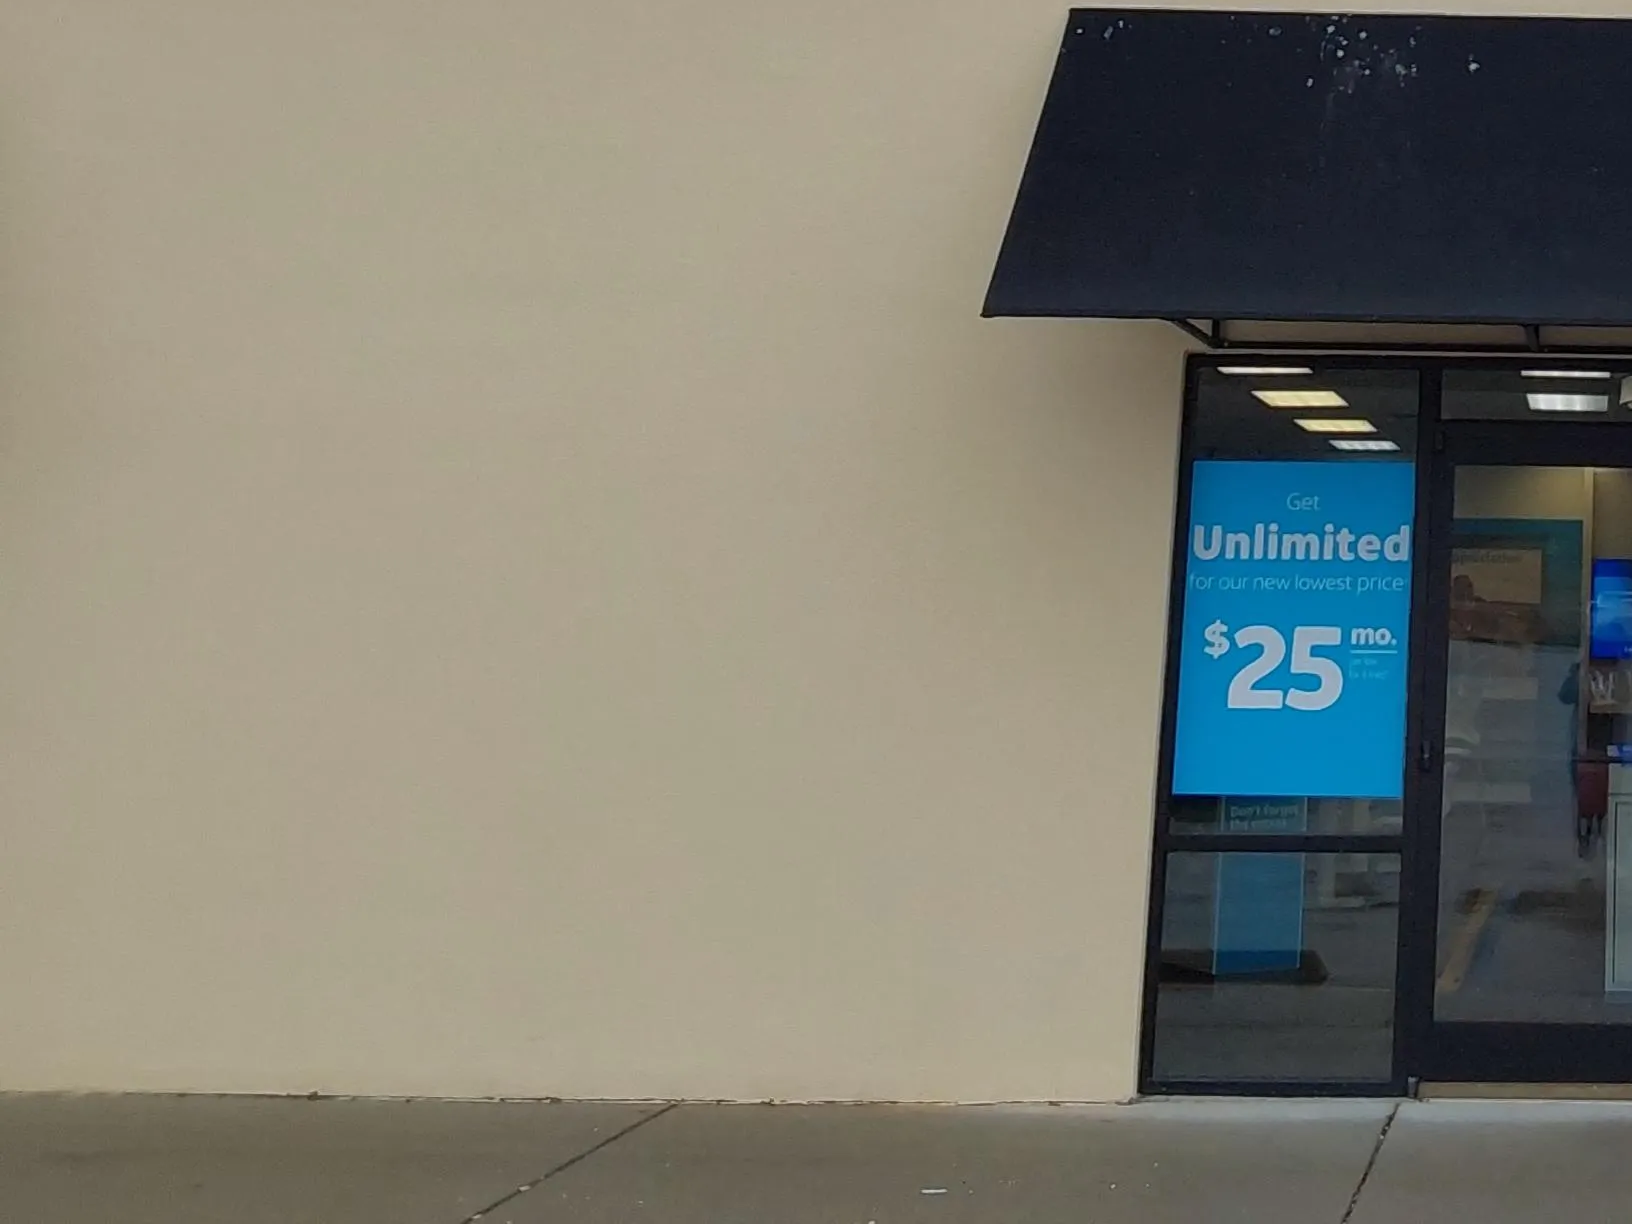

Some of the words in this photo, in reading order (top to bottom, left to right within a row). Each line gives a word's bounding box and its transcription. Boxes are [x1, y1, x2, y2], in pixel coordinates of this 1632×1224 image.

[1286, 492, 1321, 511] Get
[1193, 523, 1410, 562] Unlimited
[1190, 573, 1216, 591] for
[1218, 576, 1248, 591] our
[1253, 576, 1290, 591] new
[1294, 575, 1352, 592] lowest
[1356, 575, 1405, 595] price
[1351, 627, 1398, 646] mo.
